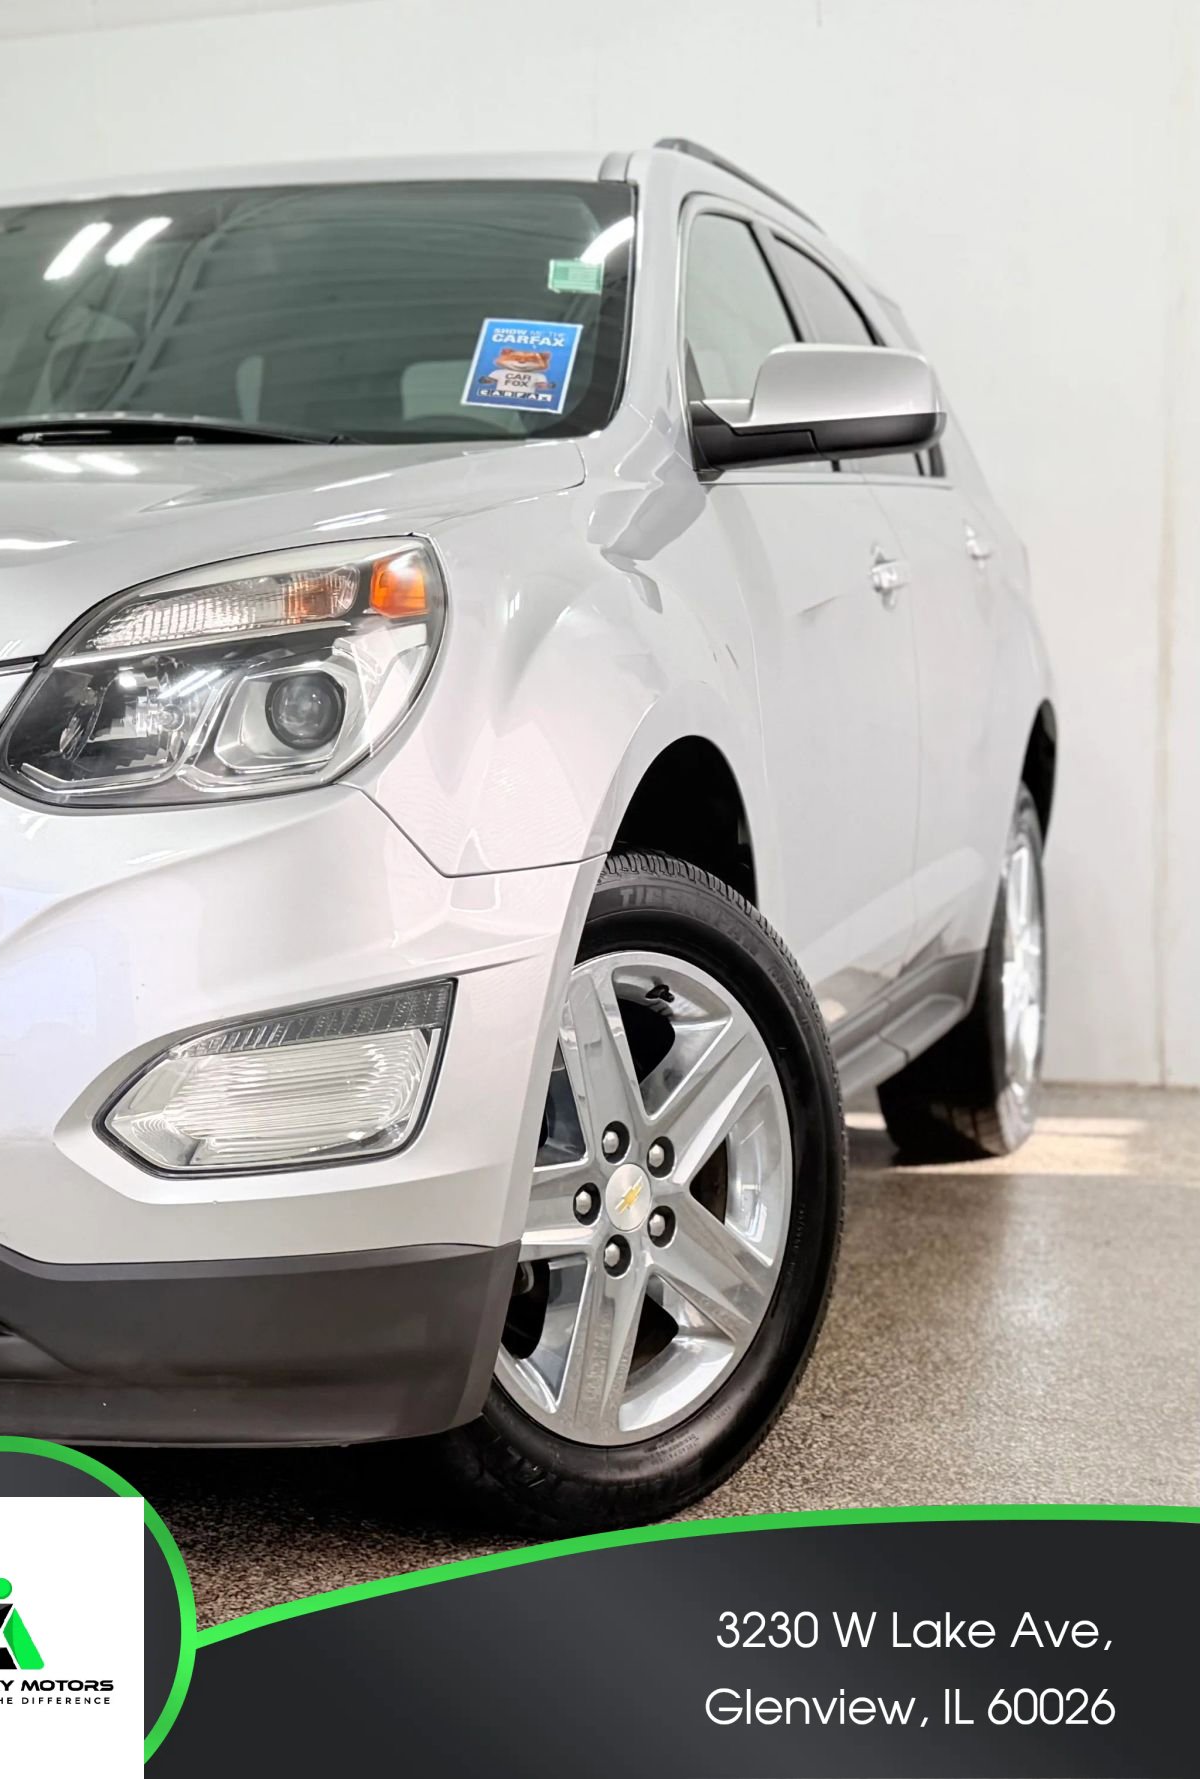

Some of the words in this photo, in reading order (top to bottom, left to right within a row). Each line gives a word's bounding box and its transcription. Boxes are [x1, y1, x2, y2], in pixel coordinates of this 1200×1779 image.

[492, 333, 565, 347] CARFAX
[505, 373, 531, 381] CAR
[504, 380, 529, 388] FOX
